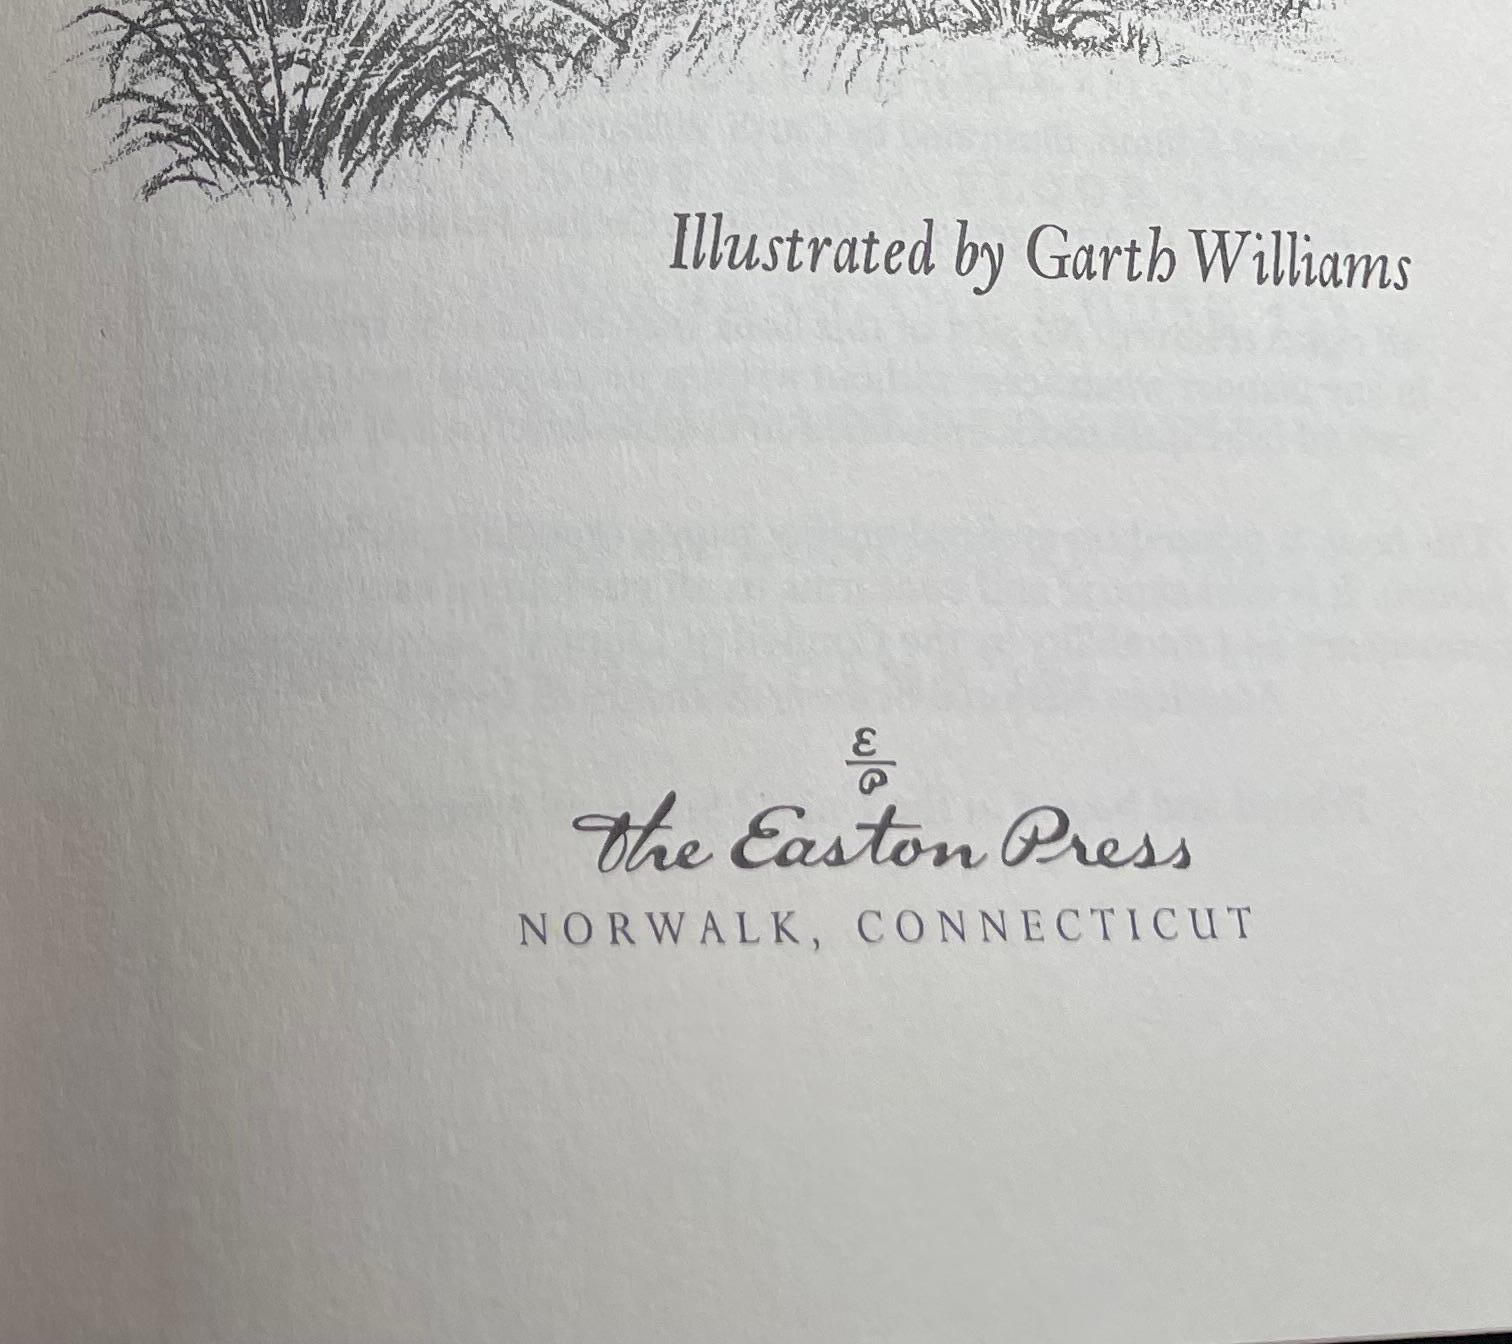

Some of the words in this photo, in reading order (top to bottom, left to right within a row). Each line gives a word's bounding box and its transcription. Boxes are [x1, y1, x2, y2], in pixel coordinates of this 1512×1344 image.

[669, 212, 935, 275] Illustrated
[955, 219, 1004, 296] by
[1027, 224, 1176, 282] Garth
[1188, 229, 1411, 290] Williams
[730, 804, 989, 870] Easton
[1001, 805, 1193, 870] Press
[519, 911, 819, 951] NORWALK,
[858, 907, 1251, 943] CONNECTICUT
